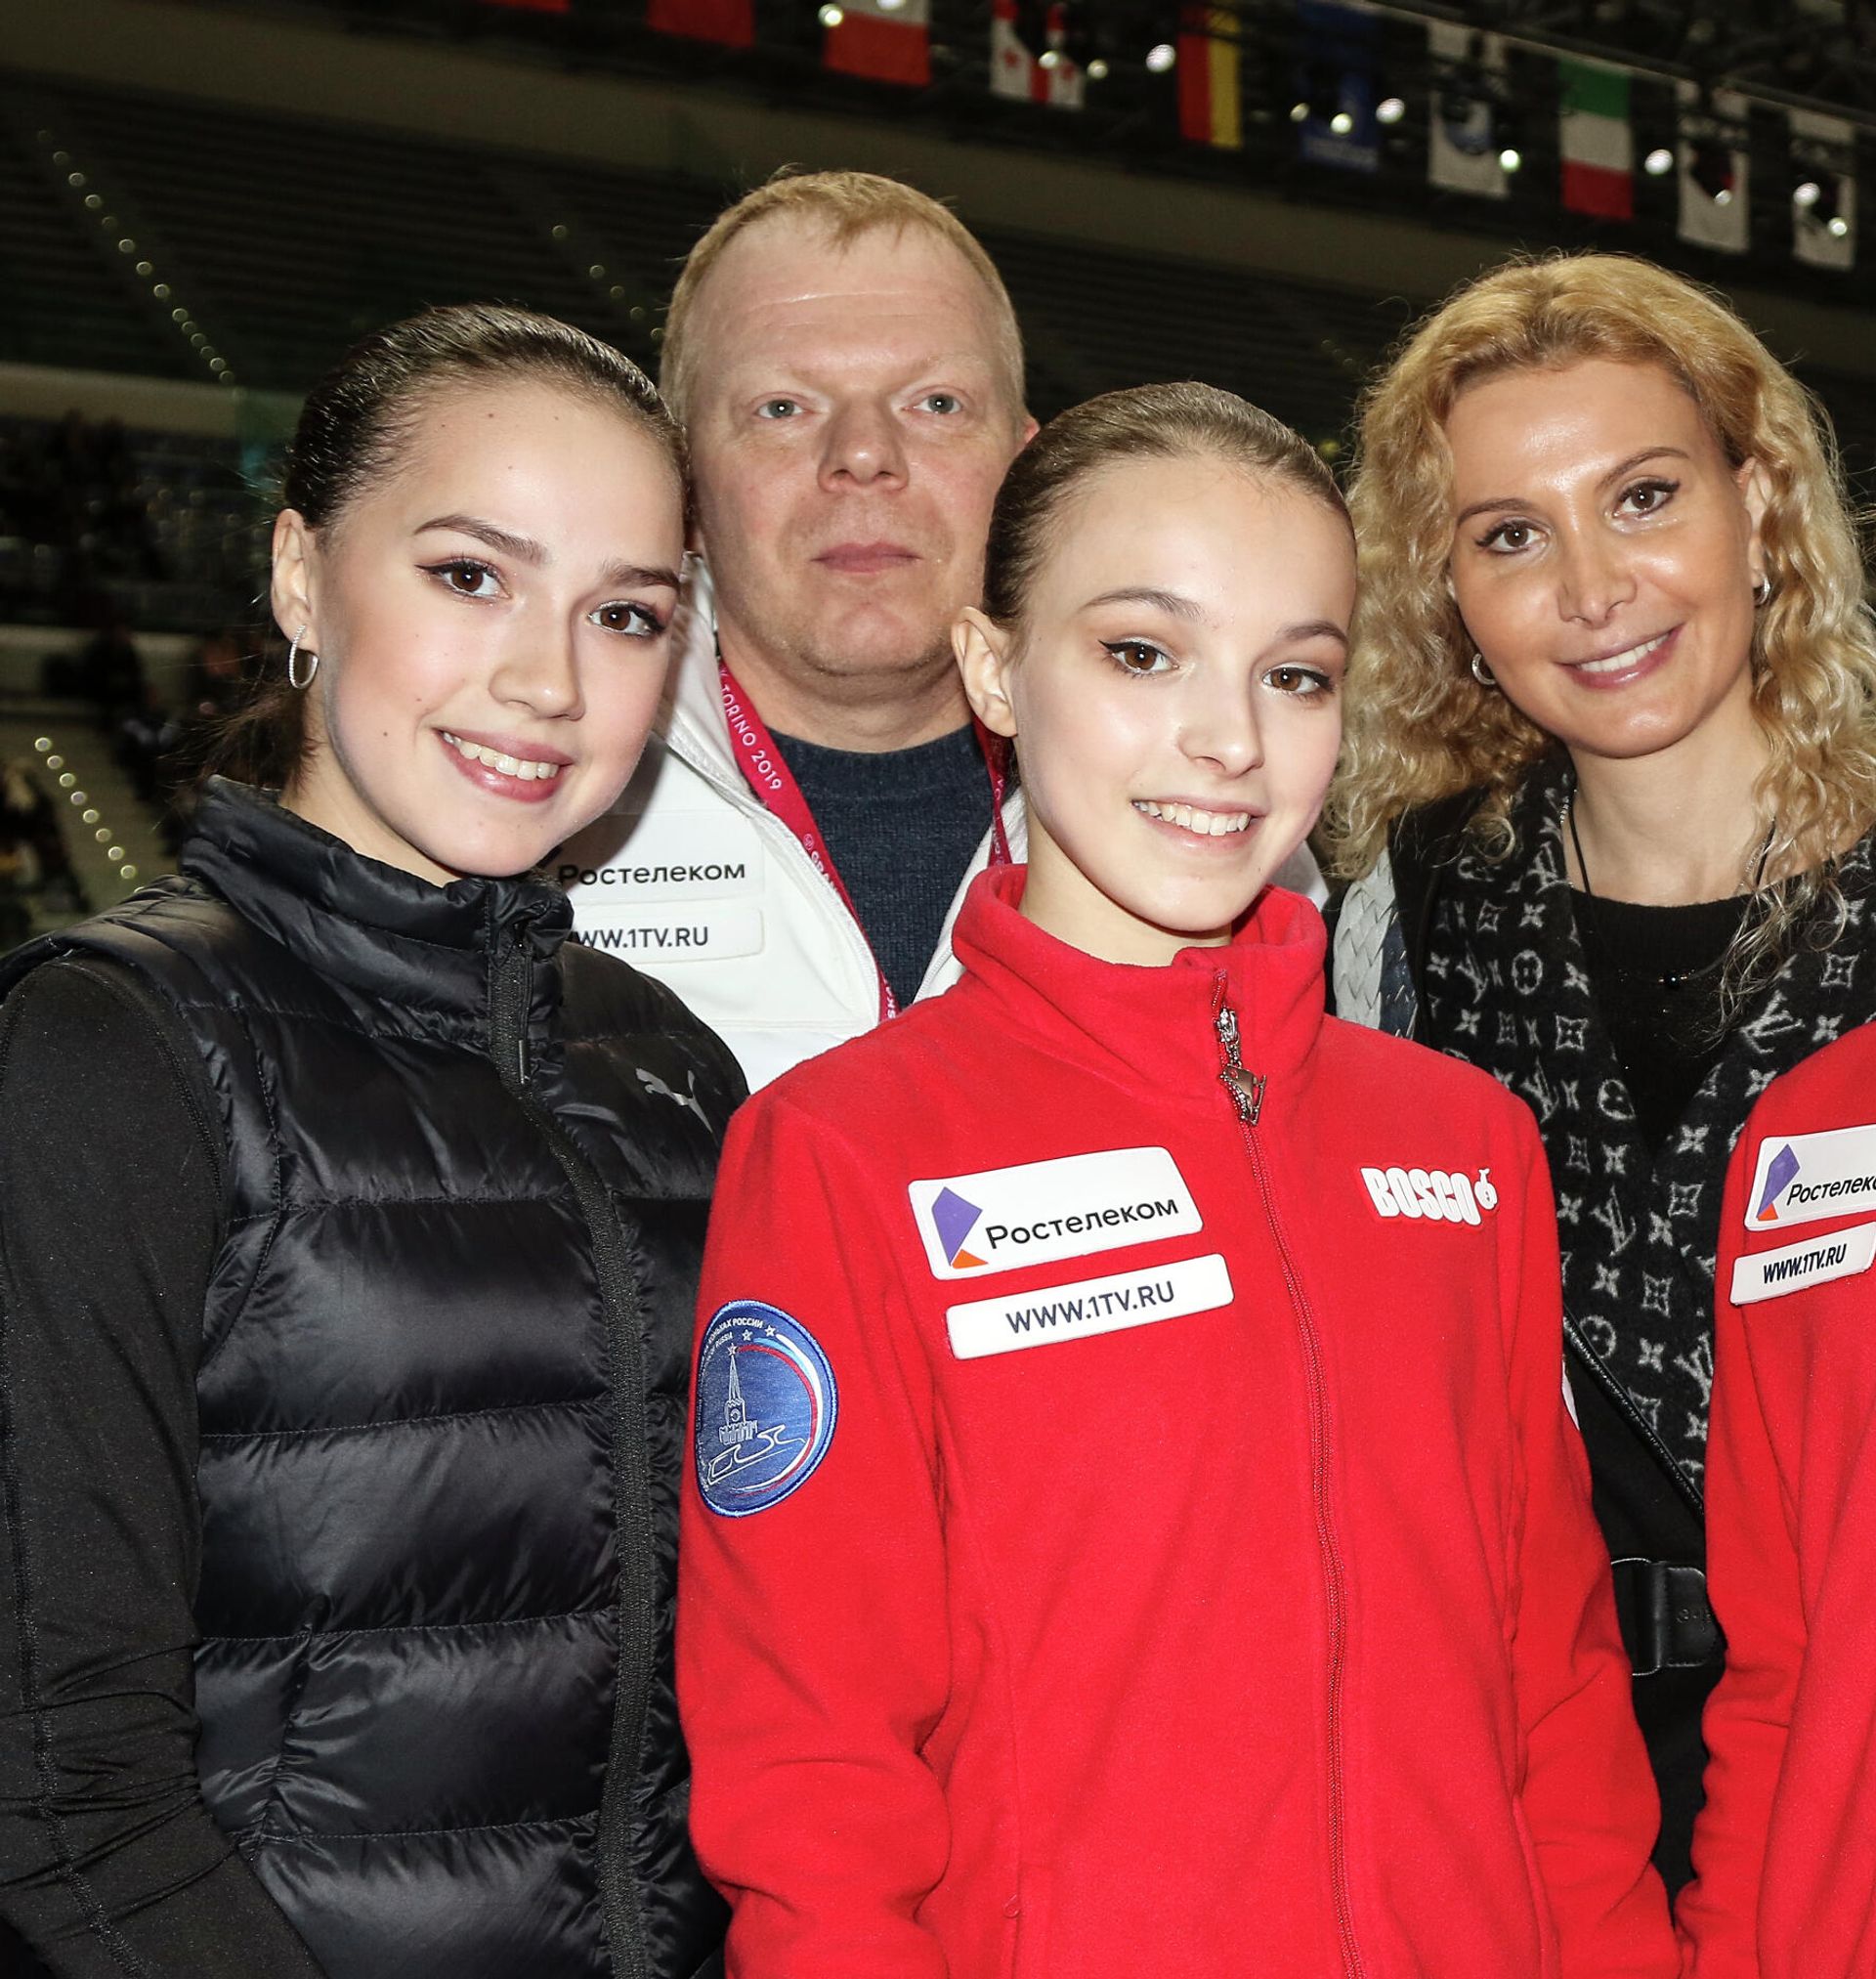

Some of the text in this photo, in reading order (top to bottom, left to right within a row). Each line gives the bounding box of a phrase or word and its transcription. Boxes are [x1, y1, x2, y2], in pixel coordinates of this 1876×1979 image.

[721, 683, 783, 790] TORINO 2019
[558, 863, 746, 885] Ростелеком
[567, 925, 708, 949] WW.1TV.RU
[1360, 1166, 1481, 1226] BOSCO
[985, 1198, 1178, 1250] Ростелеком
[1763, 1243, 1848, 1284] WWW.1TV.RU
[732, 1316, 764, 1328] РОССИИ
[1006, 1280, 1175, 1335] WWW.1TV.RU
